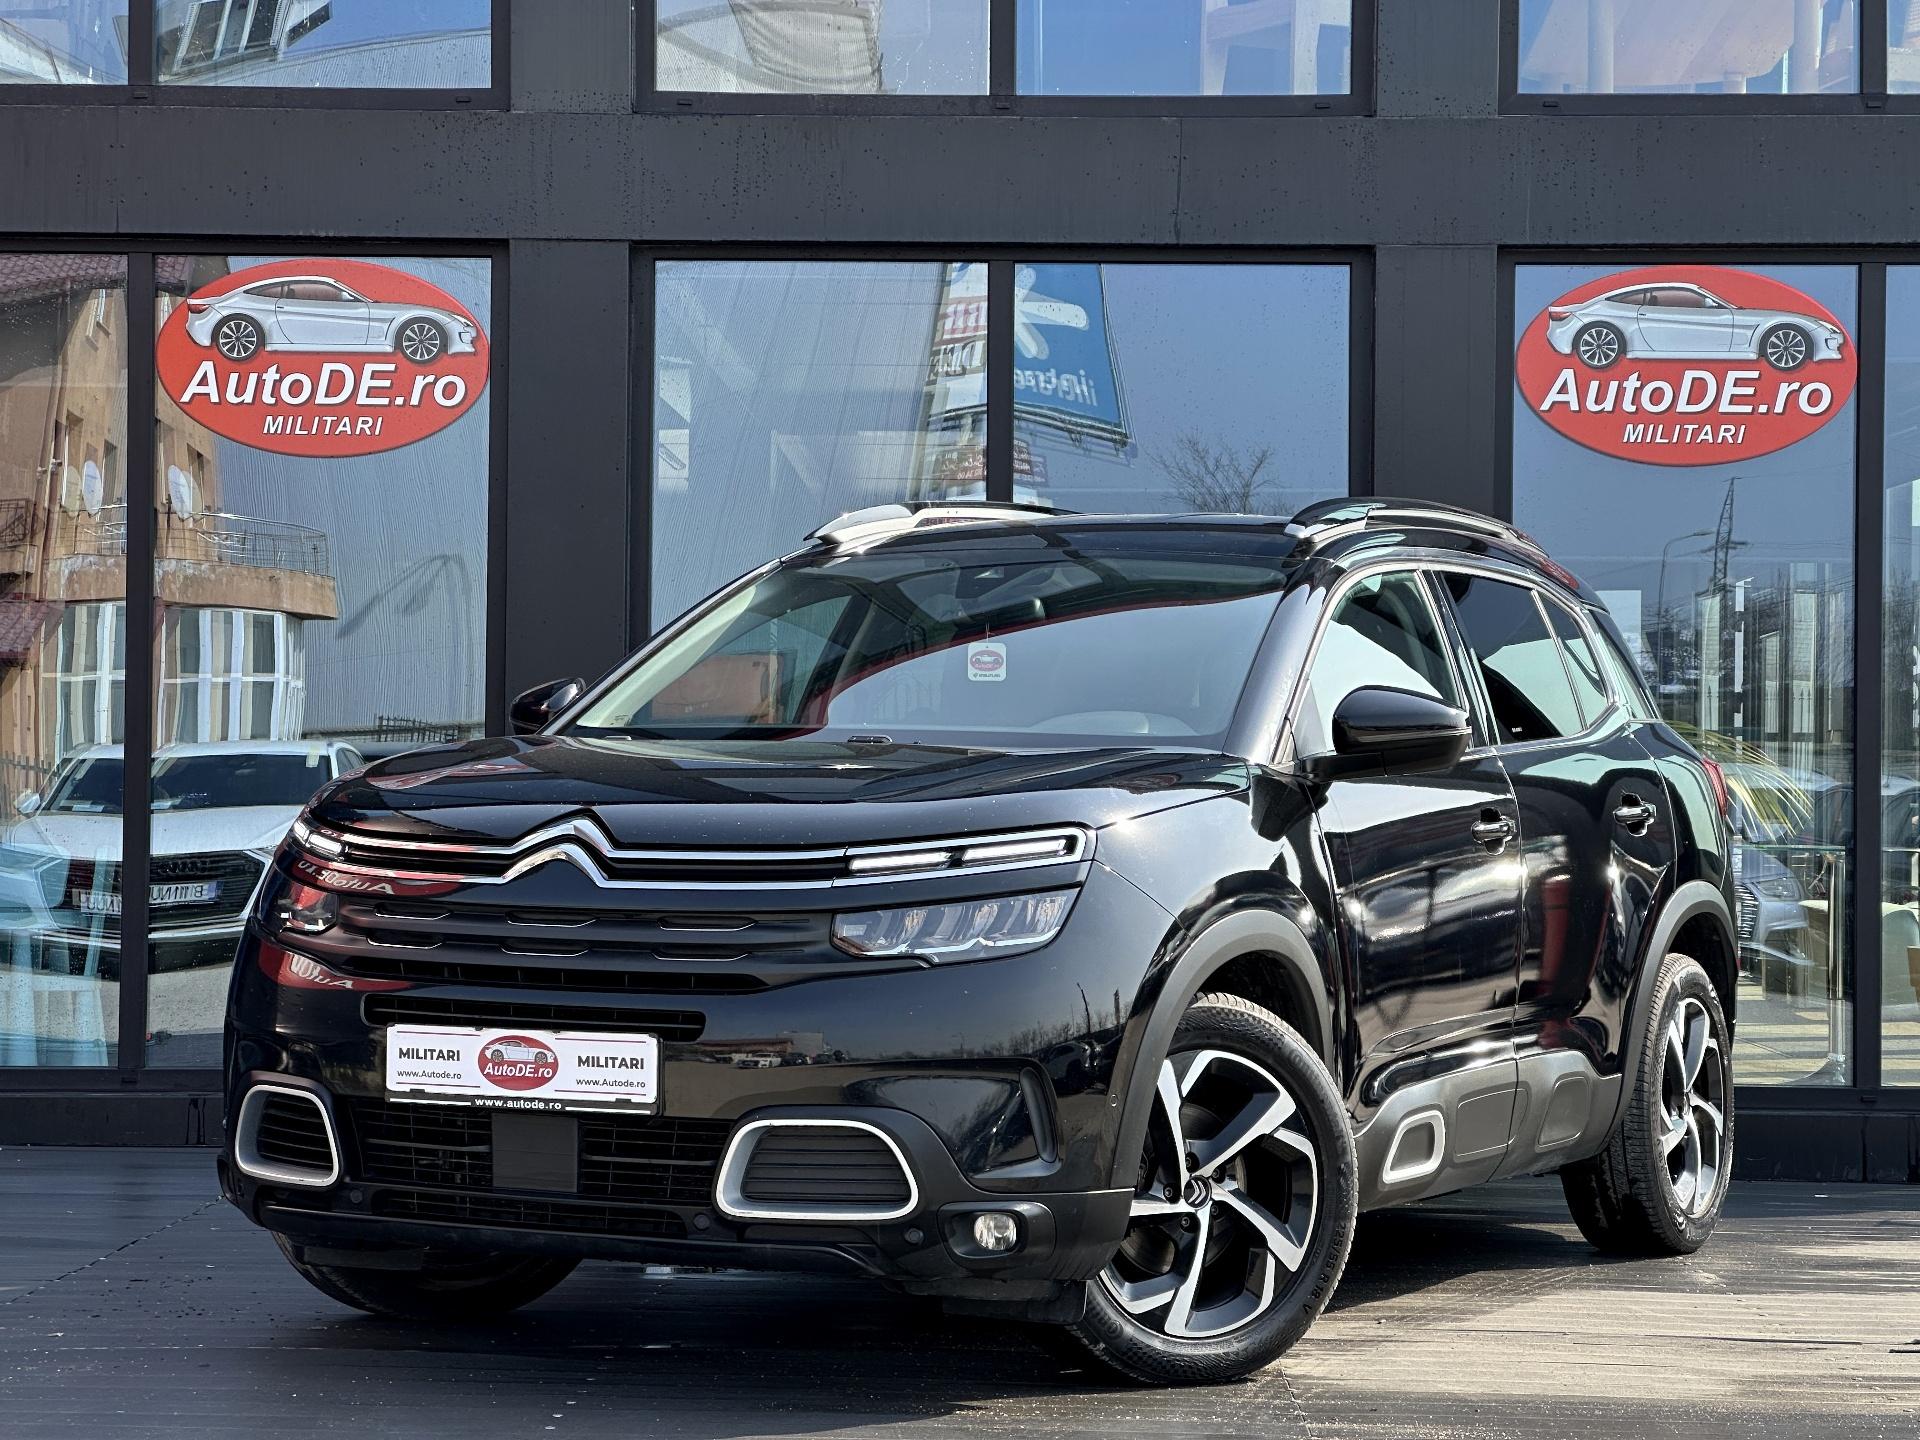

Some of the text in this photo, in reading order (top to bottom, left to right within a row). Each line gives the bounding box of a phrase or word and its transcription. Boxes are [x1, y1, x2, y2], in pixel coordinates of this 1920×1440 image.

[179, 361, 467, 407] AutoDE.ro
[1539, 368, 1832, 415] AutoDE.ro
[263, 416, 383, 436] MILITARI
[1622, 424, 1746, 444] MILITARI
[398, 1047, 461, 1062] MILITARI
[577, 1055, 645, 1070] MILITARI
[397, 1070, 462, 1080] www.Autode.ro
[483, 1063, 553, 1079] AutoDE.ro
[575, 1078, 646, 1088] www.Autode.ro
[474, 1097, 562, 1110] www.autode.ro
